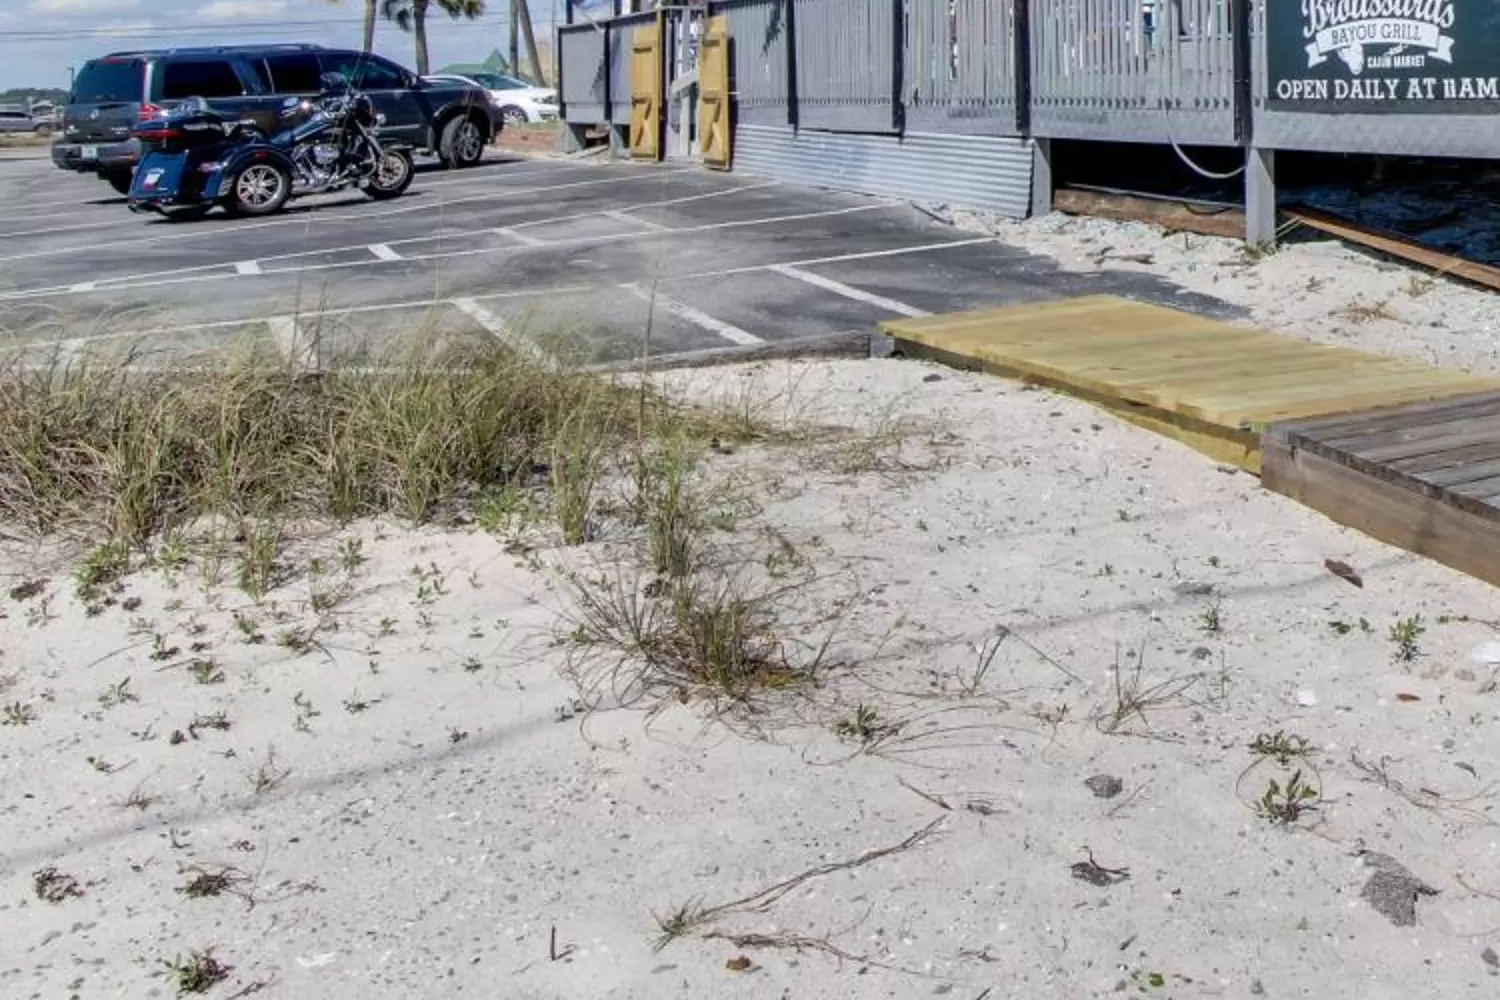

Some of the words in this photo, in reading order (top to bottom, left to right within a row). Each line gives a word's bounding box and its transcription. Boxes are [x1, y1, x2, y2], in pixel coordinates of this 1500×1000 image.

[1331, 24, 1377, 46] BAYOU
[1380, 23, 1423, 41] GRILL
[1393, 54, 1425, 68] MARKET
[1277, 79, 1328, 99] OPEN
[1334, 78, 1400, 99] DAILY
[1406, 77, 1436, 99] AT
[1443, 77, 1500, 99] 11AM
